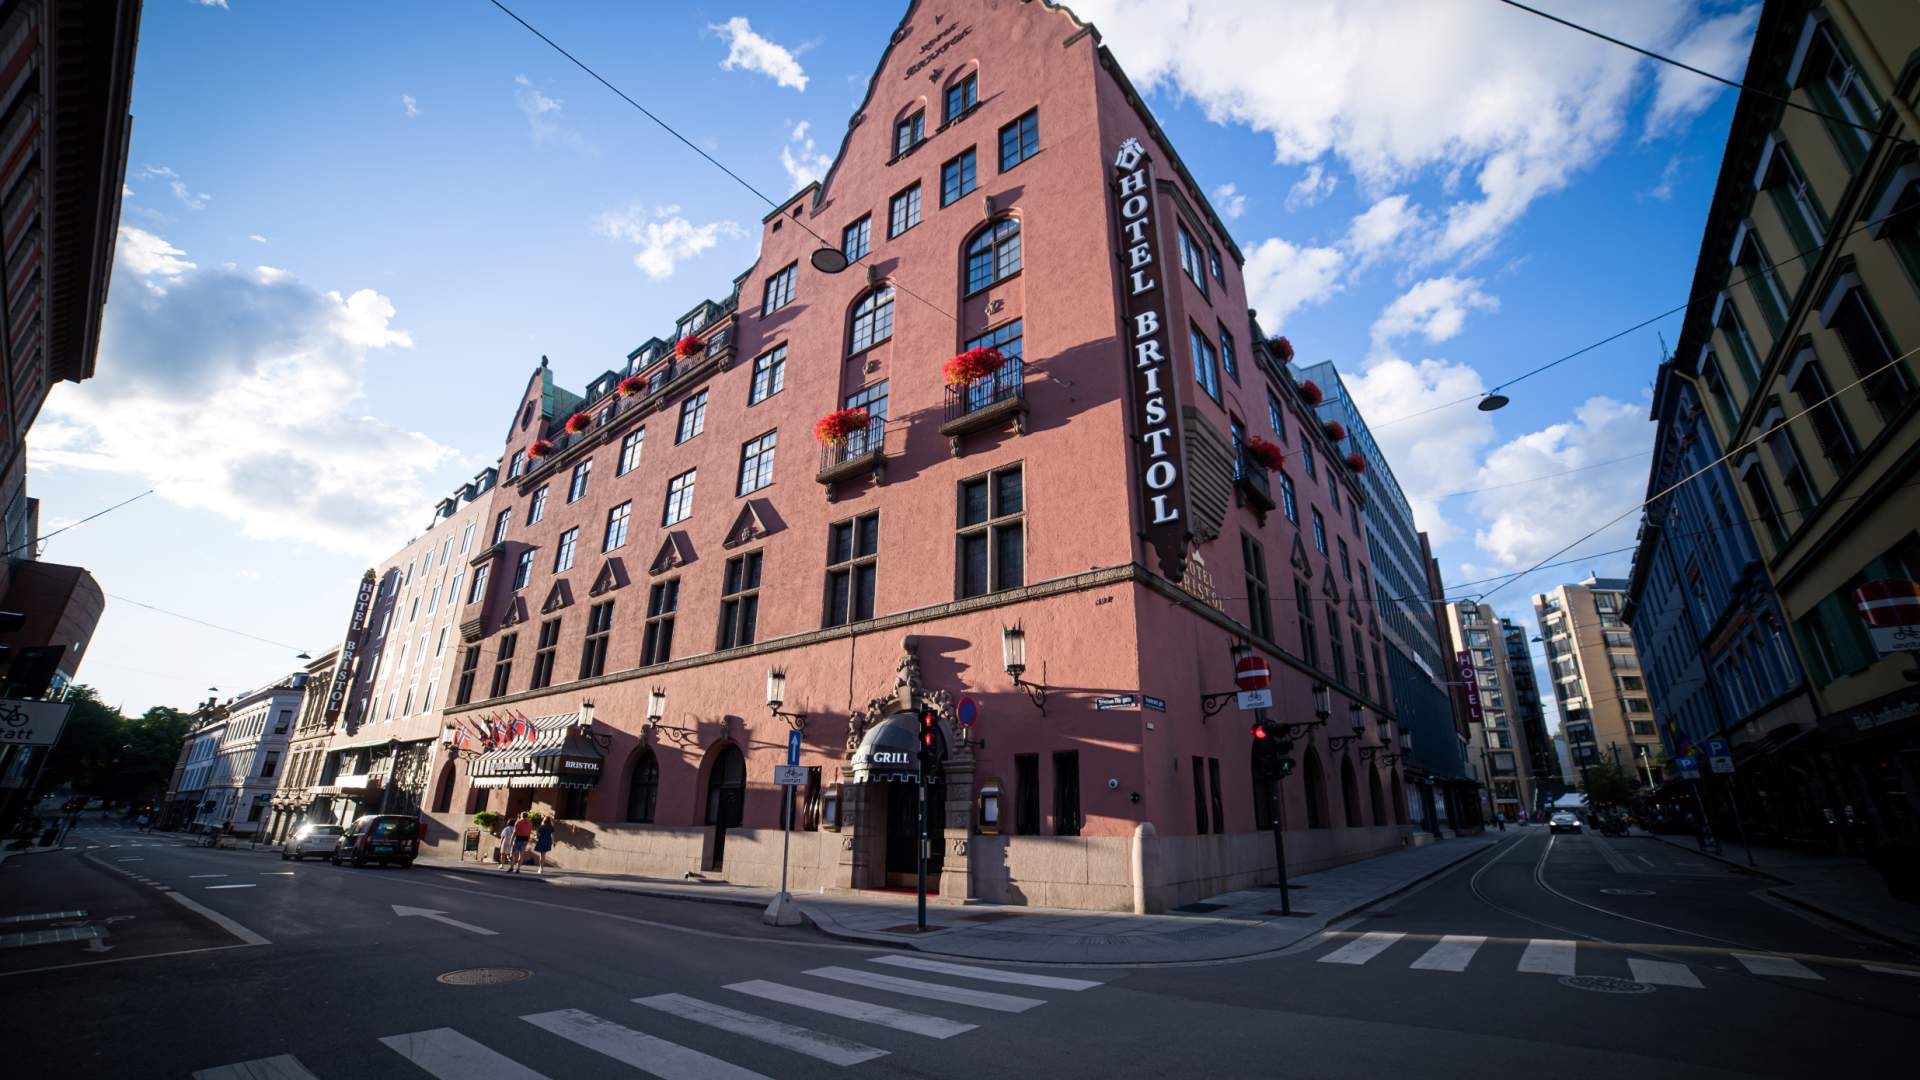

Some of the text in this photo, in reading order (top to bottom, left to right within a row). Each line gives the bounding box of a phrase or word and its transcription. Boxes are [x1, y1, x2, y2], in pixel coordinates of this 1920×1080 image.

[1118, 168, 1180, 524] HOTEL BRISTOL
[1185, 558, 1216, 589] OTEL
[328, 582, 373, 711] HOTEL BRISTOL
[1460, 655, 1480, 718] HOTEL
[873, 752, 910, 764] GRILL
[1710, 741, 1722, 755] P
[564, 761, 600, 771] BRISTOL
[1681, 759, 1691, 768] P
